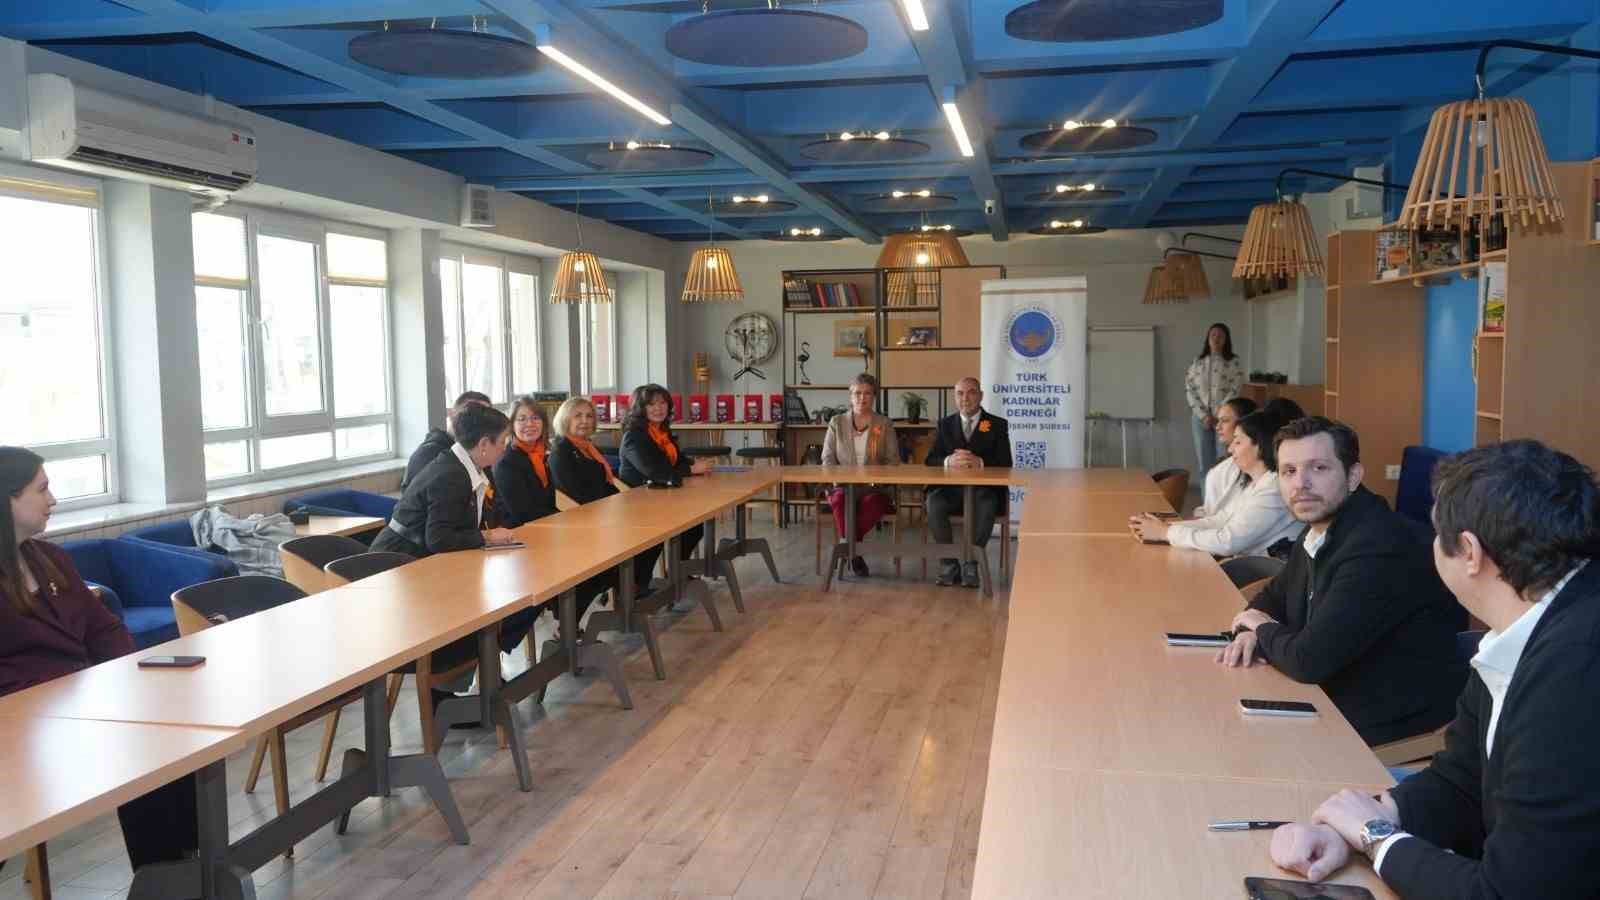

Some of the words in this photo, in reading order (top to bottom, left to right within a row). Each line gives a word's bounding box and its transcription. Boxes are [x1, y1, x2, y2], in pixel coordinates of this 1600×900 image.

[992, 383, 1071, 394] ÜNİVERSİTELİ
[1002, 397, 1060, 406] KADINLAR
[1007, 408, 1056, 418] DERNEĞİ
